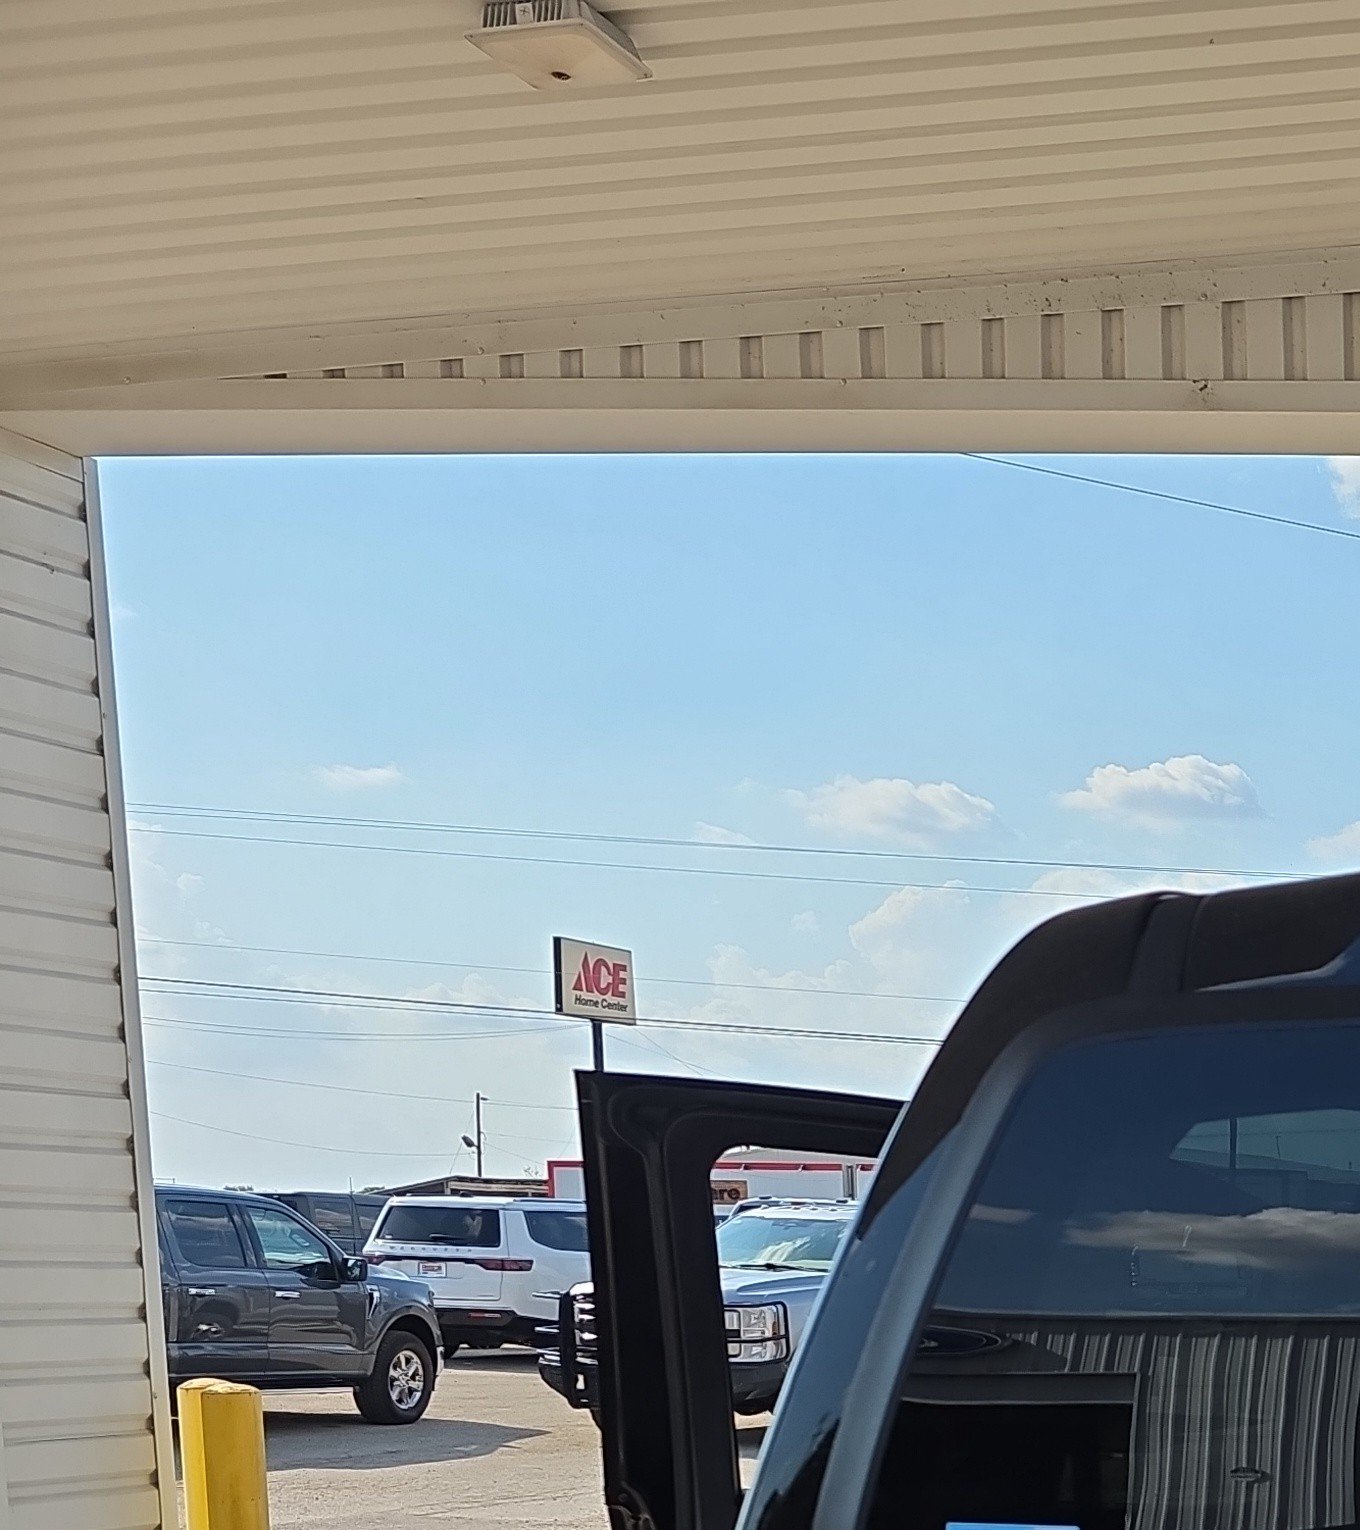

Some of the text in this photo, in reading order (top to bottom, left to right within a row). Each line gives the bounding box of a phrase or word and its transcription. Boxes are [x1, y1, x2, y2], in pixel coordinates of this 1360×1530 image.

[572, 951, 627, 998] ACE
[574, 994, 628, 1012] Home Center
